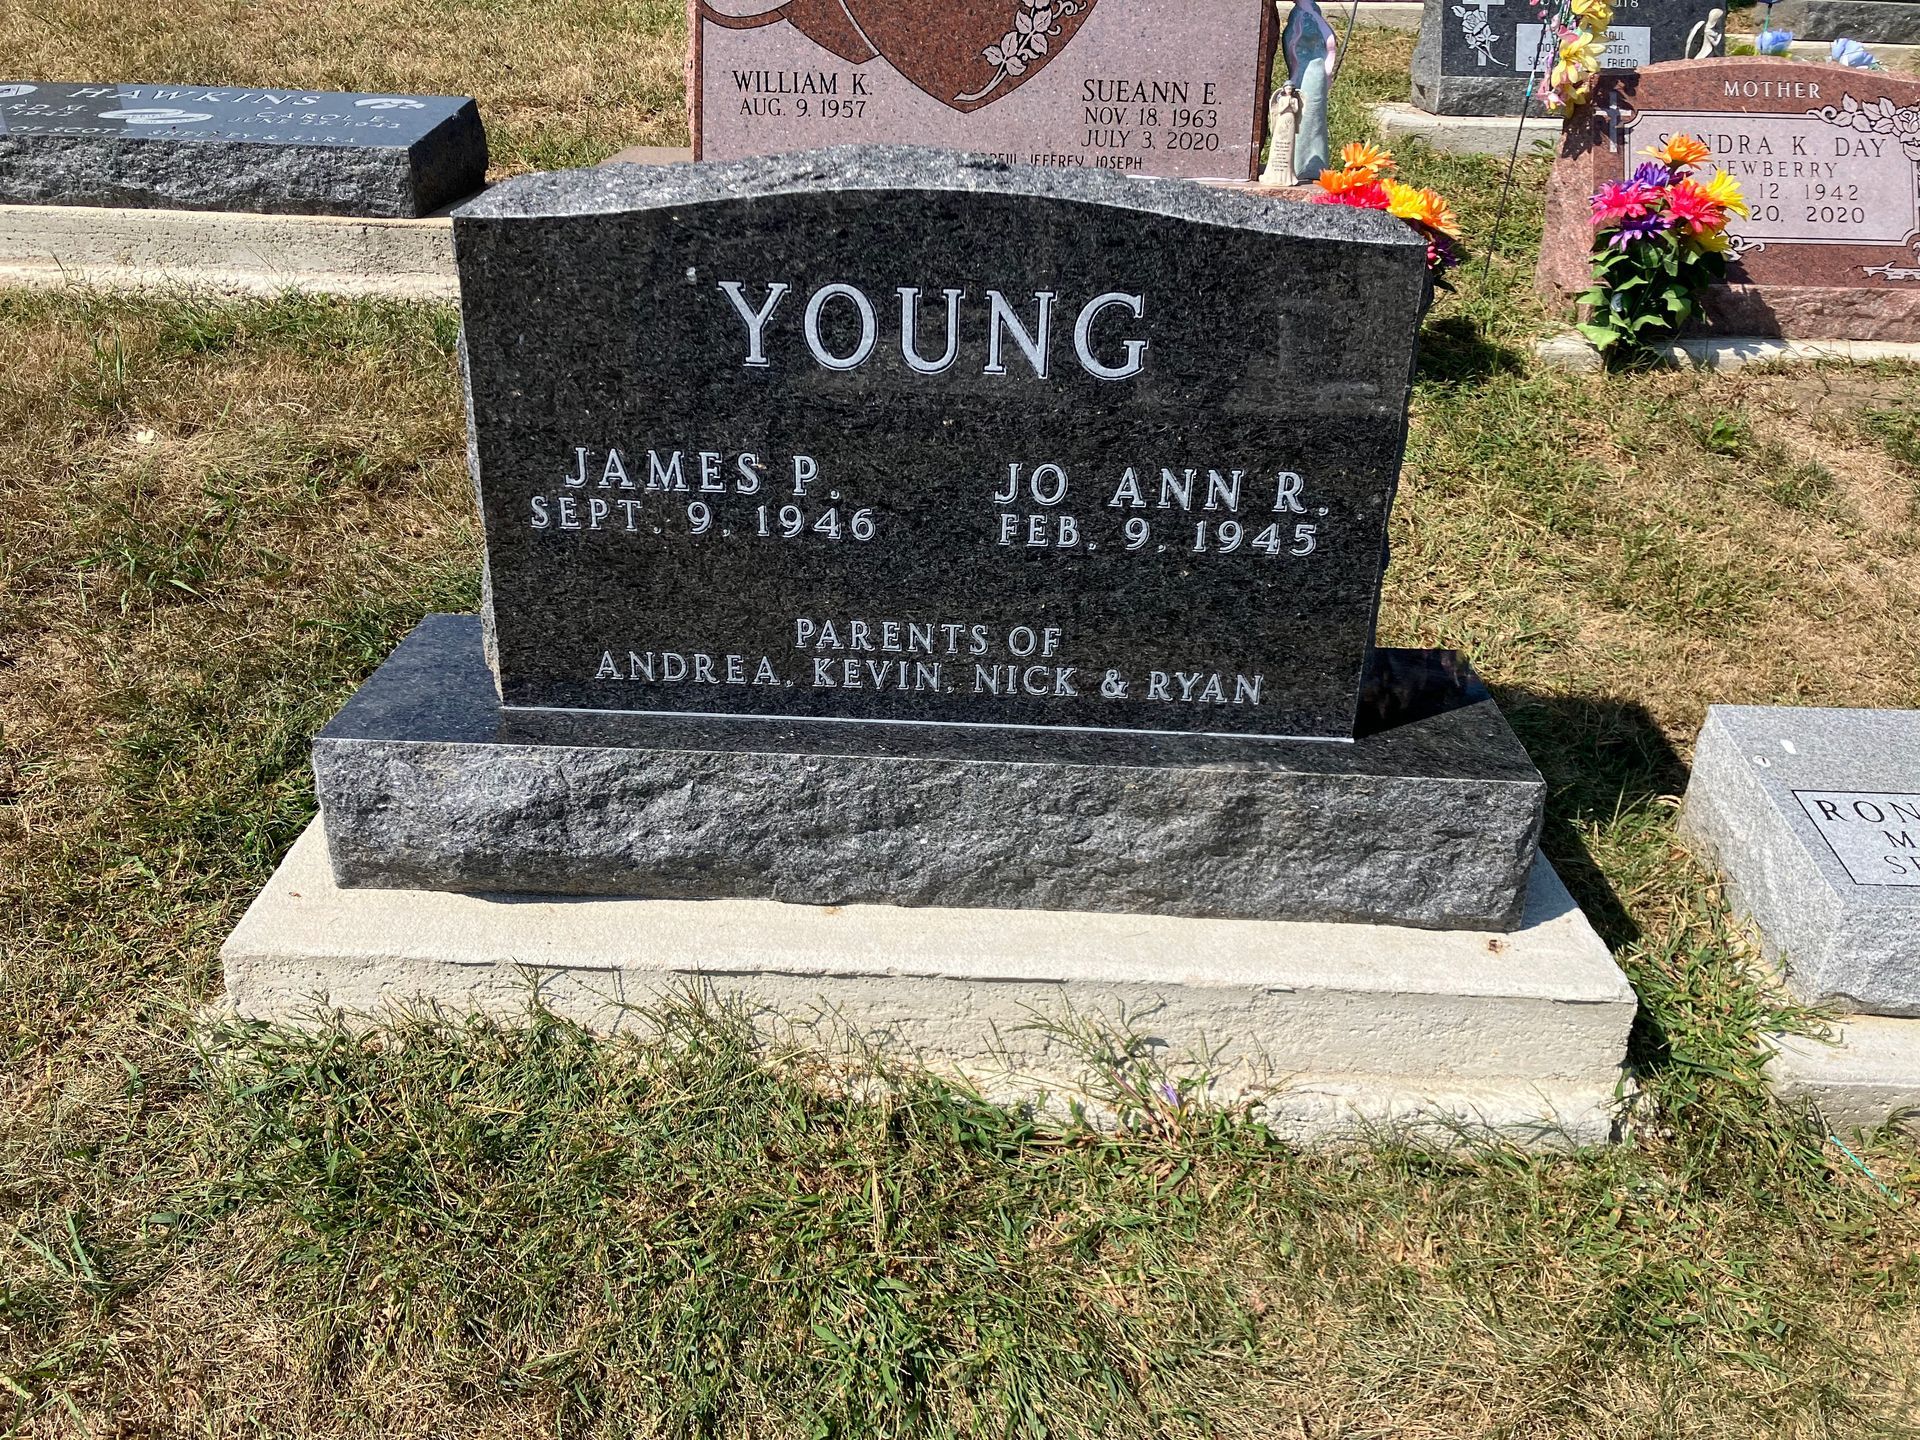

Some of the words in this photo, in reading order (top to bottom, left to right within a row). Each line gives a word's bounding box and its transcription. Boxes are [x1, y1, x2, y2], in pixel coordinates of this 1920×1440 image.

[1607, 59, 1638, 68] FRIEND
[732, 70, 837, 94] WILLIAM
[852, 73, 873, 95] K.
[1082, 79, 1189, 104] SUEANN
[1202, 82, 1222, 105] E.
[1724, 80, 1821, 99] MOTHER
[66, 87, 320, 105] HAWKINS
[740, 97, 786, 116] AUG.
[821, 99, 866, 118] 1957
[256, 111, 353, 121] CAROL
[1084, 107, 1129, 126] NOV.
[1172, 109, 1217, 128] 1963
[1081, 129, 1131, 148] JULY
[1142, 131, 1156, 150] 3,
[1167, 131, 1219, 151] 2020
[1658, 132, 1773, 155] SNDRA
[1792, 135, 1817, 156] K.
[1835, 137, 1887, 158] DAY
[1708, 160, 1839, 179] NEWBERRY
[1805, 184, 1858, 201] 1942
[1806, 206, 1864, 224] 2020
[717, 280, 1147, 381] YOUNG
[564, 447, 761, 495] JAMES
[792, 454, 840, 500] P.
[994, 462, 1069, 506] JO
[1108, 466, 1245, 512] ANN
[1272, 471, 1329, 517] R.
[530, 495, 662, 534] SEPT.
[756, 504, 876, 541] 1946
[998, 513, 1097, 550] FEB.
[1192, 519, 1317, 557] 1945
[795, 617, 989, 655] PARENTS
[1007, 625, 1062, 658] OF
[812, 657, 954, 694] KEVIN,
[973, 663, 1078, 697] NICK
[1100, 668, 1129, 699] &
[1146, 670, 1264, 705] RYAN
